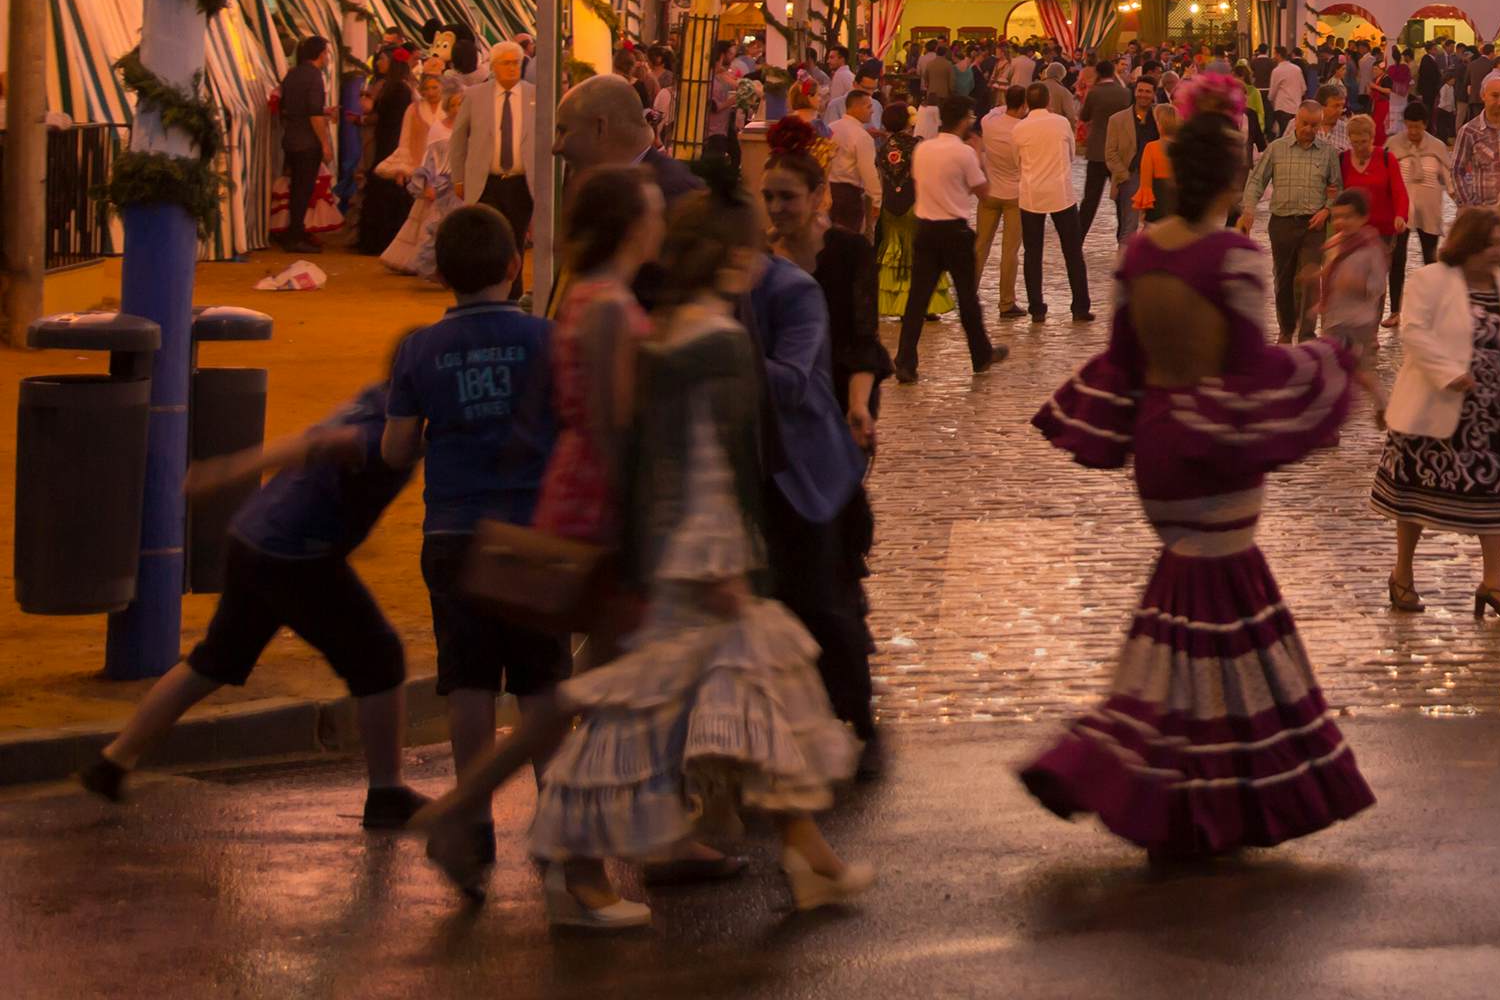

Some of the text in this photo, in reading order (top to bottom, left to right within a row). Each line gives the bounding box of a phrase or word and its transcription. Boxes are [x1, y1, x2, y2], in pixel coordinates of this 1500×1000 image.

[434, 346, 527, 370] LOS ANGELES
[456, 365, 512, 402] 1843
